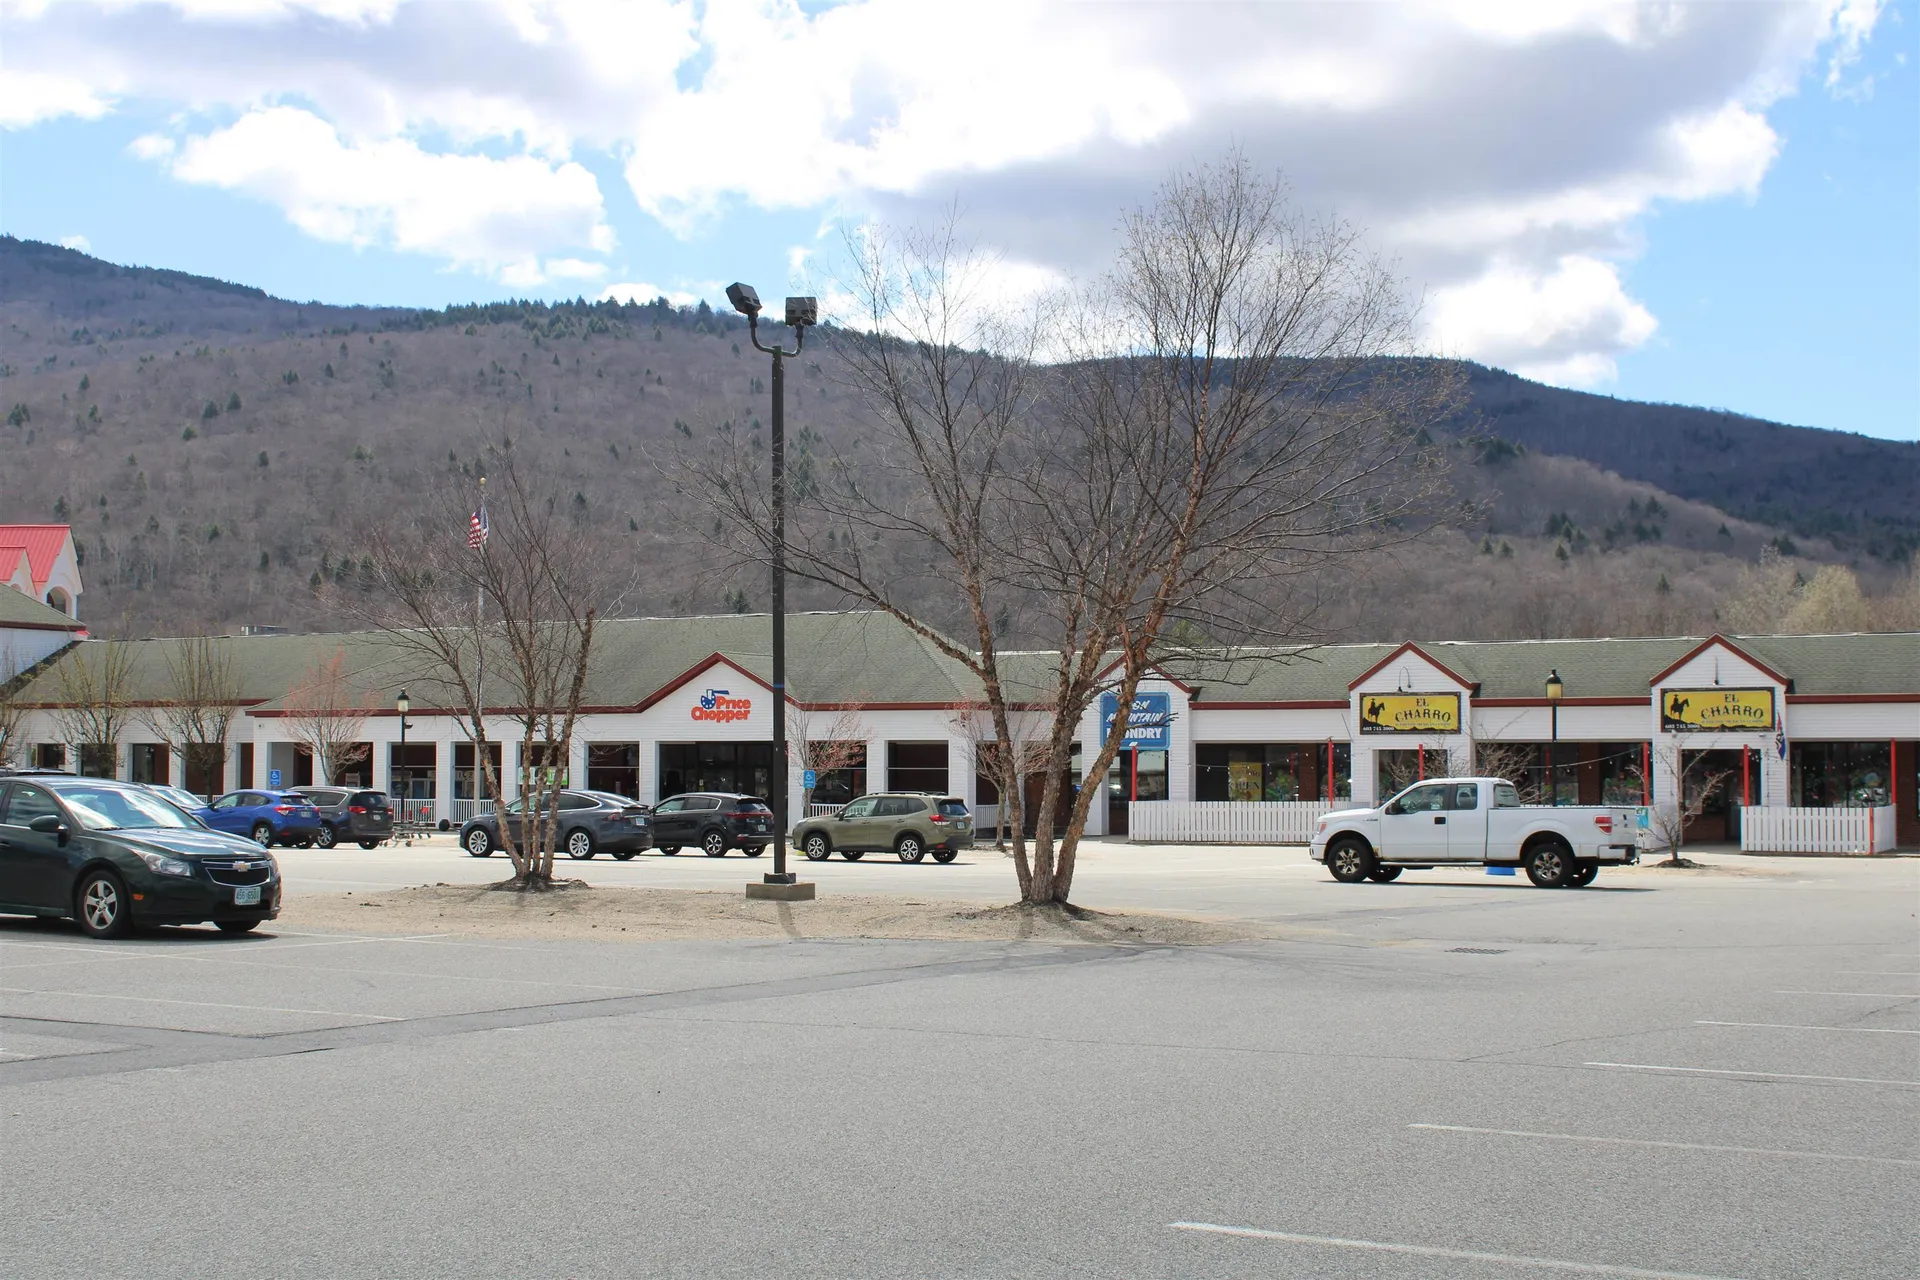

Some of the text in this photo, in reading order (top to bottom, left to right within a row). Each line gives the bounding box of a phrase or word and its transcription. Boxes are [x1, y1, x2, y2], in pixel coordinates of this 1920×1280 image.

[716, 696, 751, 709] Price
[1416, 698, 1429, 707] EL
[1724, 693, 1740, 703] EL
[691, 706, 751, 724] Chopper
[1395, 708, 1451, 723] CHARRO
[1700, 704, 1765, 720] CHARRO
